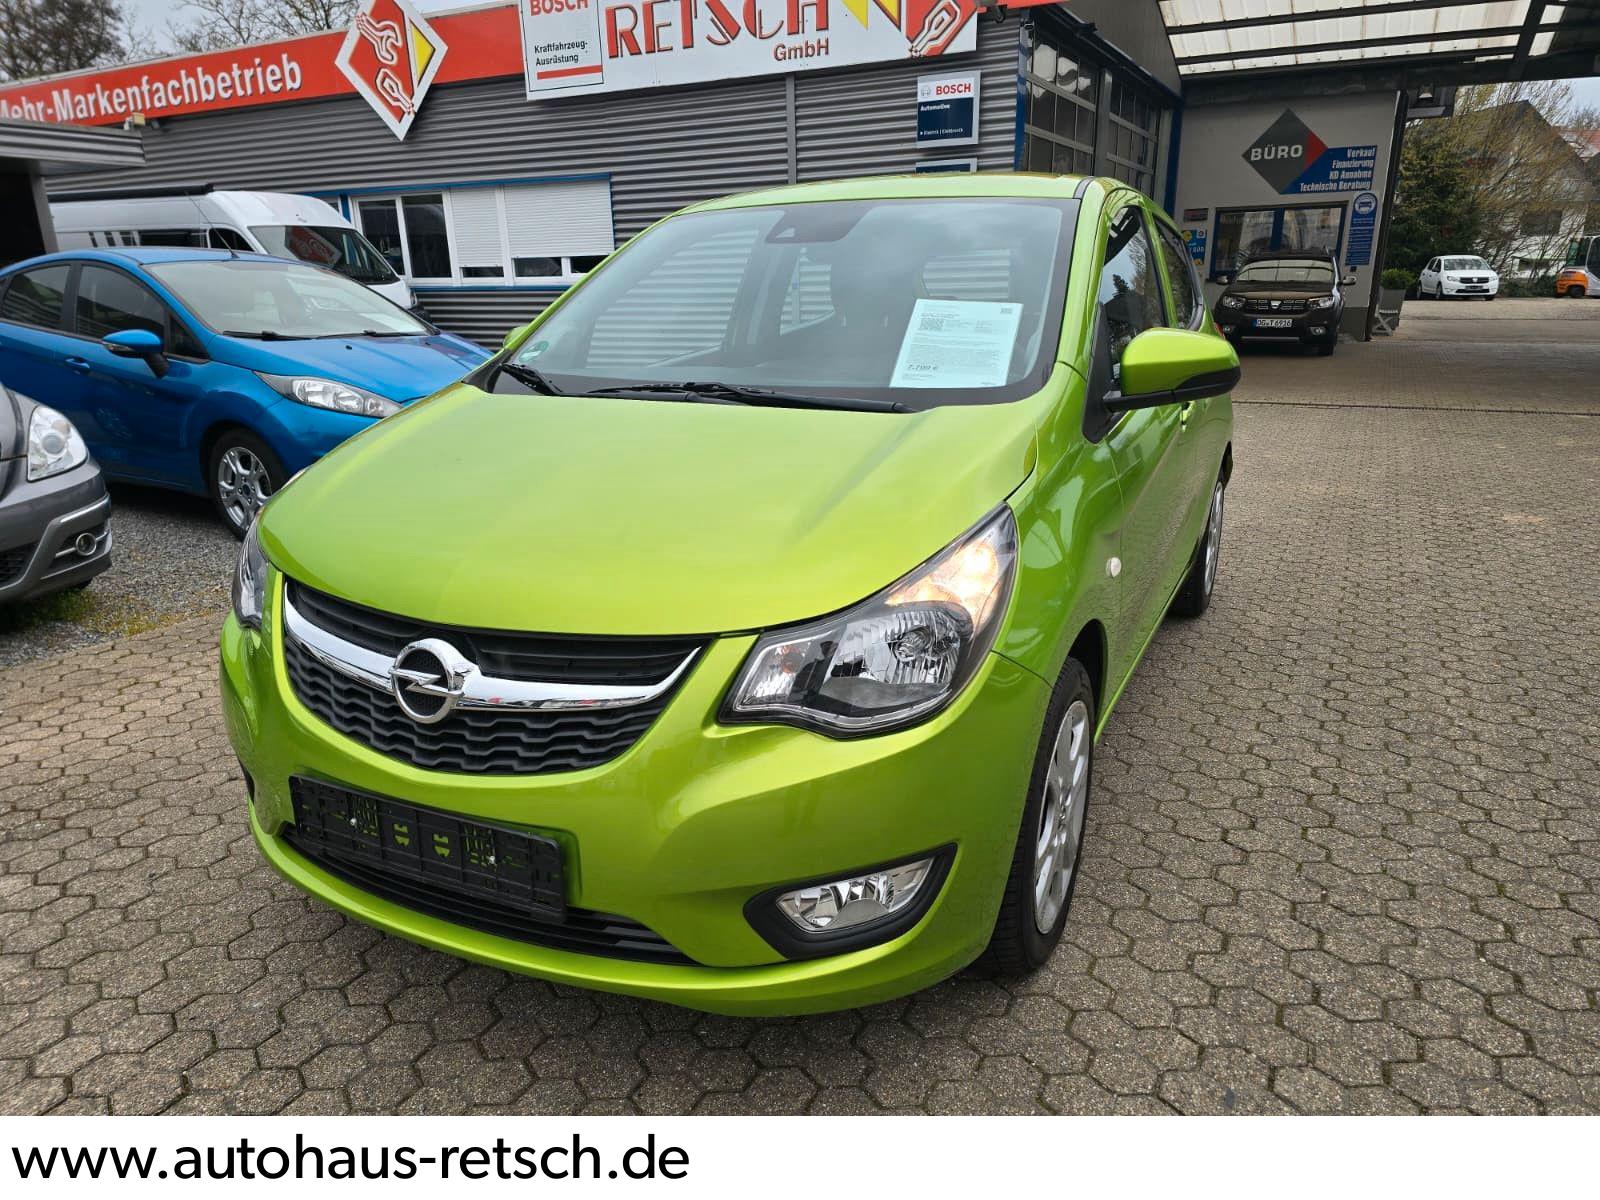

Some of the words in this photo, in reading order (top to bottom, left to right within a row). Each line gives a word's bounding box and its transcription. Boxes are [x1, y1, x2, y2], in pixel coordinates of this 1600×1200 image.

[605, 0, 829, 58] RETSCH
[534, 41, 588, 54] Kraftfahrzeug-
[773, 37, 829, 61] GmbH
[536, 54, 579, 66] Ausrüstung
[936, 83, 972, 95] BOSCH
[1250, 144, 1303, 161] BÜRO
[1347, 147, 1376, 158] Verkauf
[1332, 159, 1374, 169] Finanzierung
[1300, 182, 1337, 192] Technische
[1338, 181, 1371, 190] Beratung
